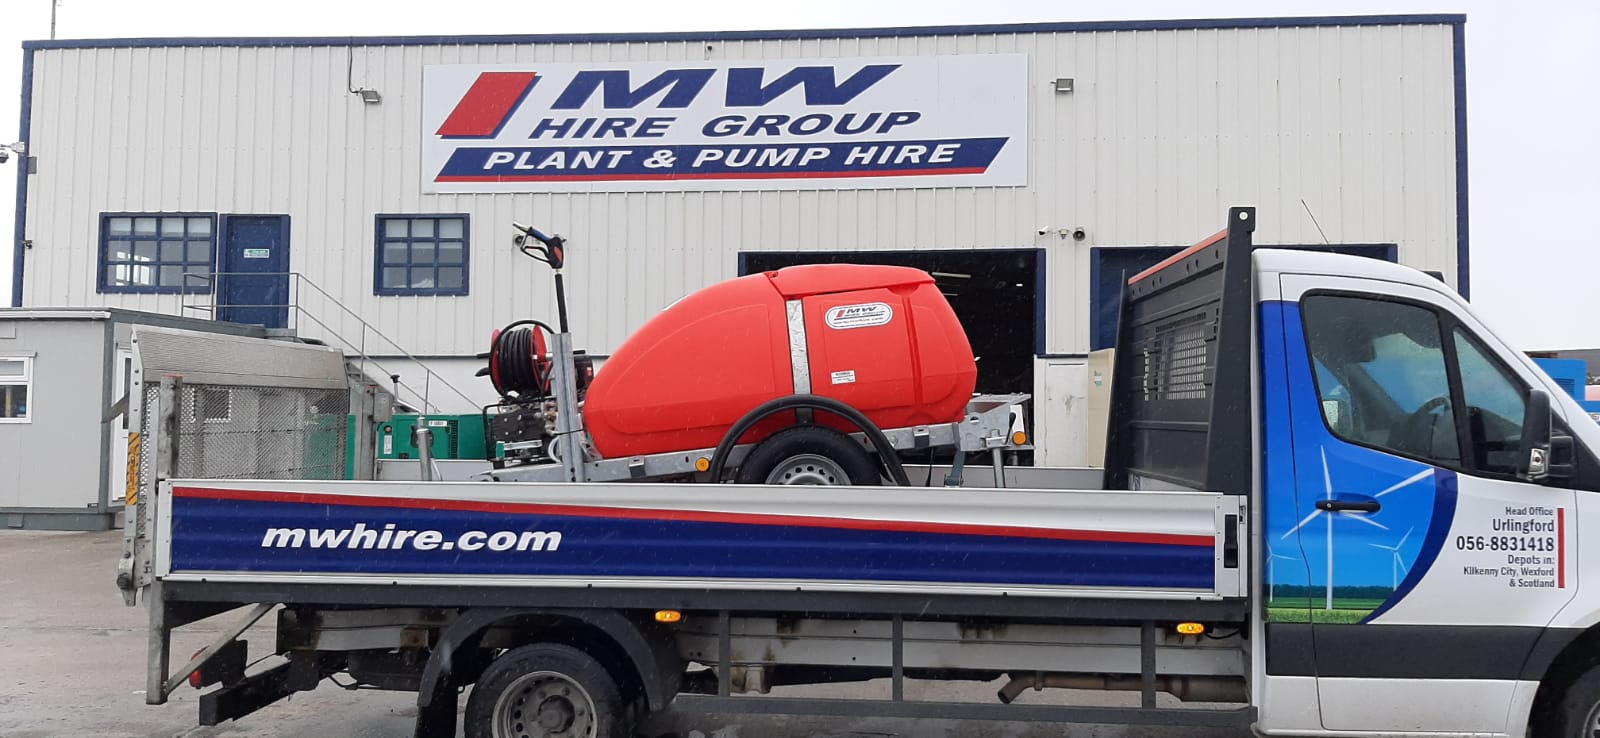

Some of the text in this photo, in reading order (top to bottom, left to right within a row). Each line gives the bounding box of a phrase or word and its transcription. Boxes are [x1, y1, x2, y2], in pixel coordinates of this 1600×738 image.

[550, 64, 903, 109] MW
[528, 111, 921, 139] HIRE GROUP
[483, 143, 961, 170] PLANT & PUMP HIRE
[847, 306, 876, 314] MW
[1506, 507, 1554, 516] Head Office
[1493, 519, 1555, 534] Urlingford
[261, 523, 562, 551] mwhire.com
[1456, 535, 1555, 552] 056-8831418
[1508, 554, 1555, 566] Depots in:
[1464, 566, 1555, 578] Kilkenny City, Wexford
[1509, 578, 1555, 588] & Scotland
